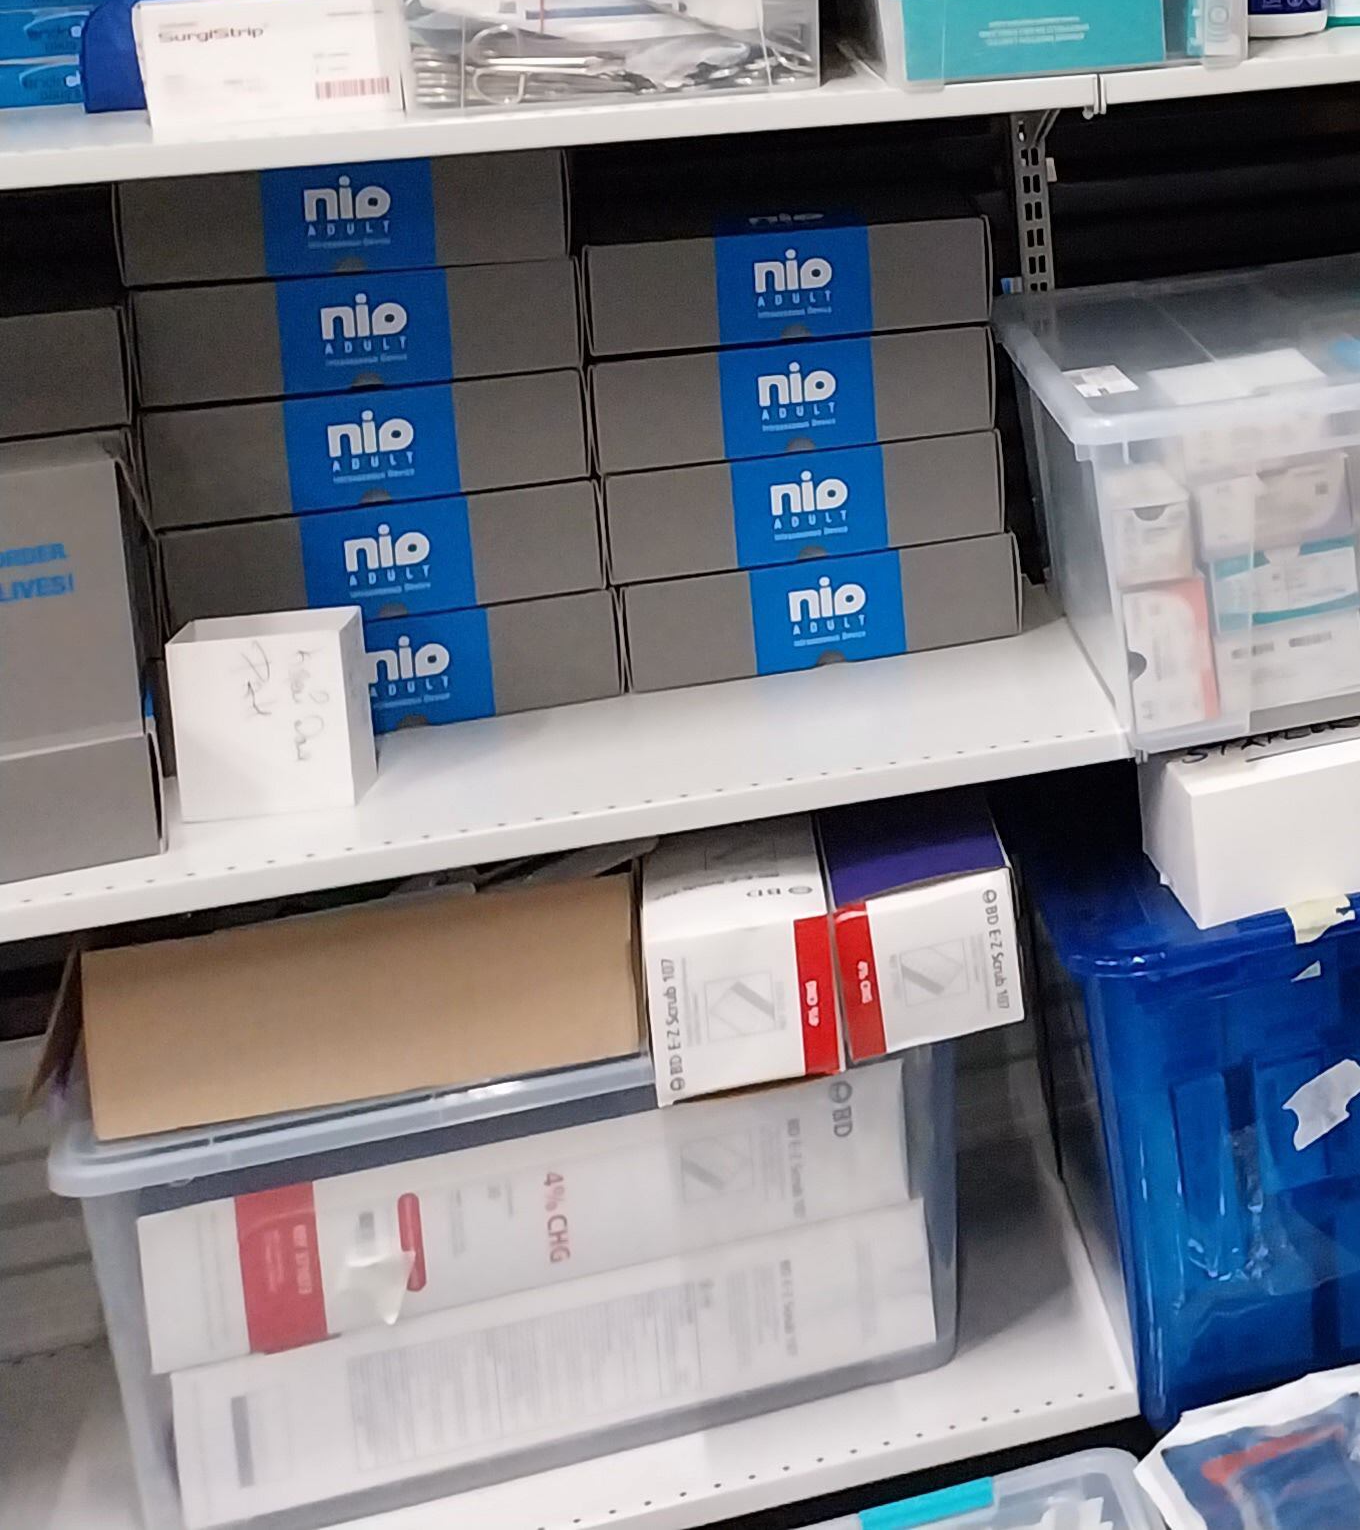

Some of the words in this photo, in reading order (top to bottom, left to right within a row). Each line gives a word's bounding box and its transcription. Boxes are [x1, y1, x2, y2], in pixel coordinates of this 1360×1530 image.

[157, 25, 265, 43] SurgiStrip
[307, 221, 391, 237] ADULT
[757, 290, 832, 308] ADULT
[324, 336, 408, 355] ADULT
[761, 401, 836, 421] ADULT
[332, 450, 414, 472] ADULT
[773, 509, 848, 530] ADULT
[349, 564, 431, 586] ADULT
[792, 614, 866, 636] ADULT
[369, 675, 450, 698] ADULT
[985, 904, 999, 926] BD
[660, 958, 675, 981] 107
[991, 951, 1008, 987] Scrub
[663, 986, 679, 1027] Scrub
[831, 1106, 854, 1138] BD
[543, 1170, 567, 1212] 4%
[546, 1214, 571, 1265] CHG
